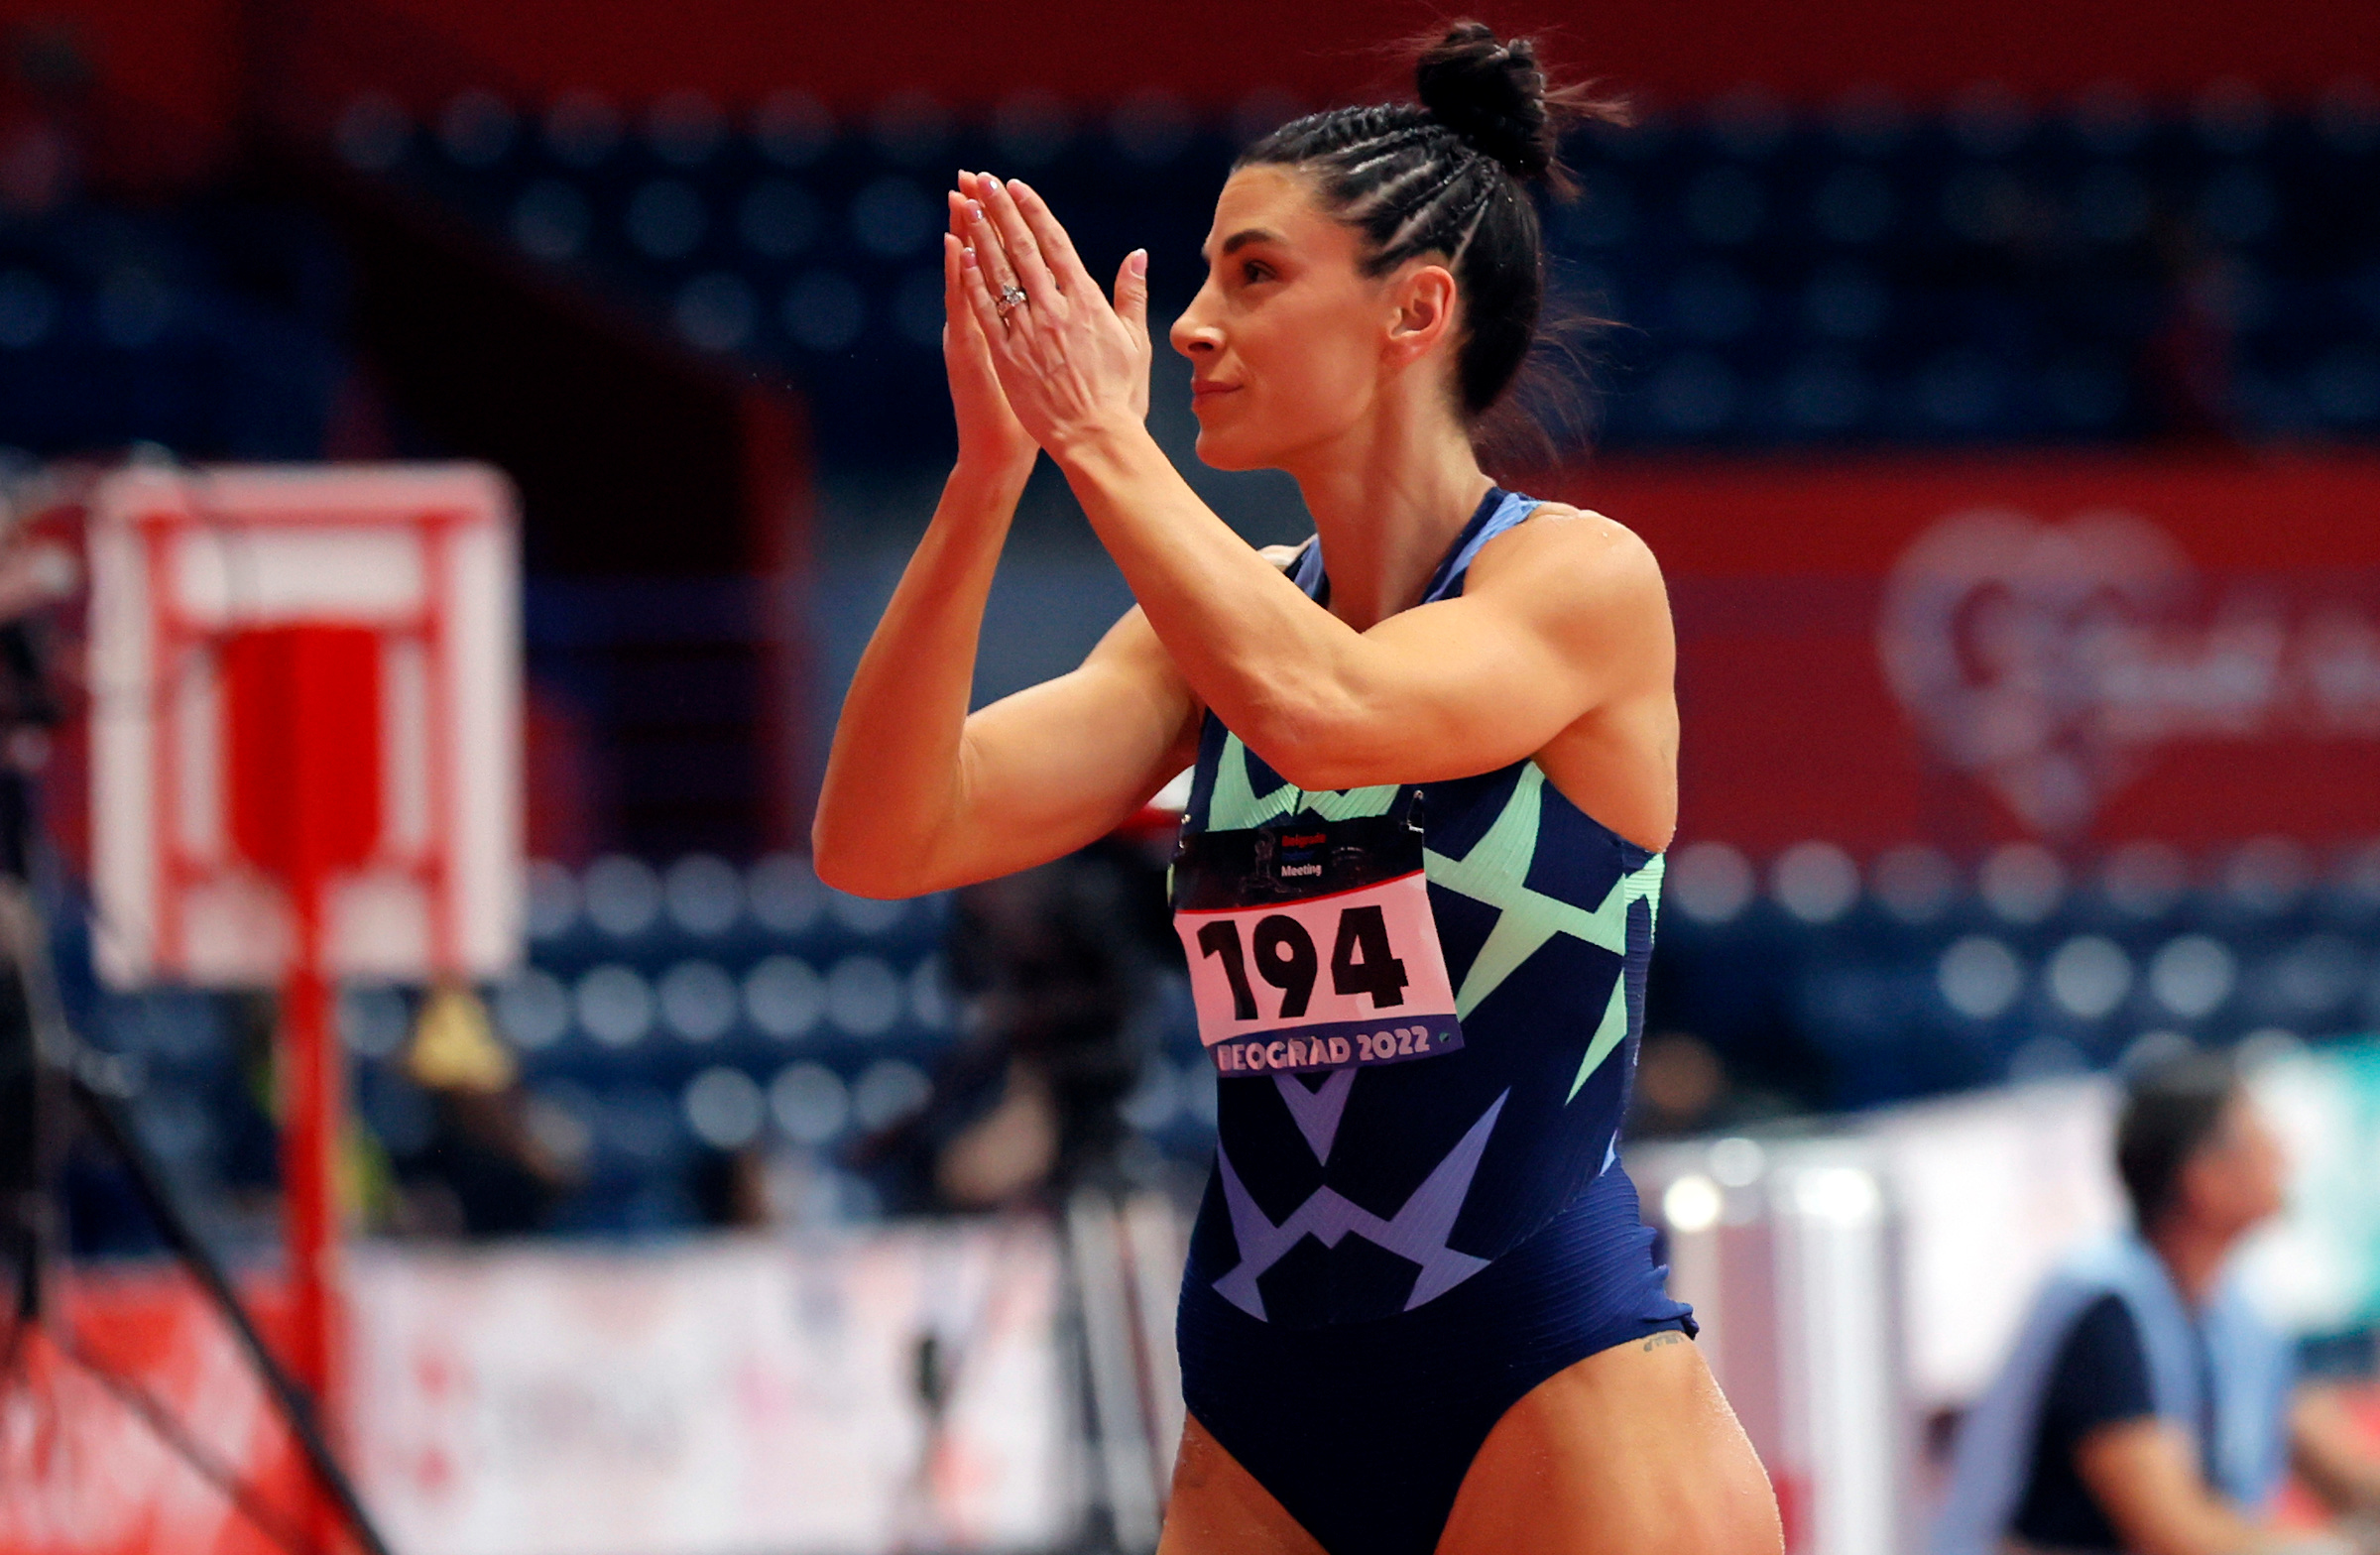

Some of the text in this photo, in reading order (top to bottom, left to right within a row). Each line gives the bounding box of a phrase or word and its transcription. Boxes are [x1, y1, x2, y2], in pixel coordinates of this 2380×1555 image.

[1280, 864, 1322, 877] Meeting
[1197, 906, 1409, 1020] 194
[1217, 1025, 1430, 1071] BEOGRAD 2022
